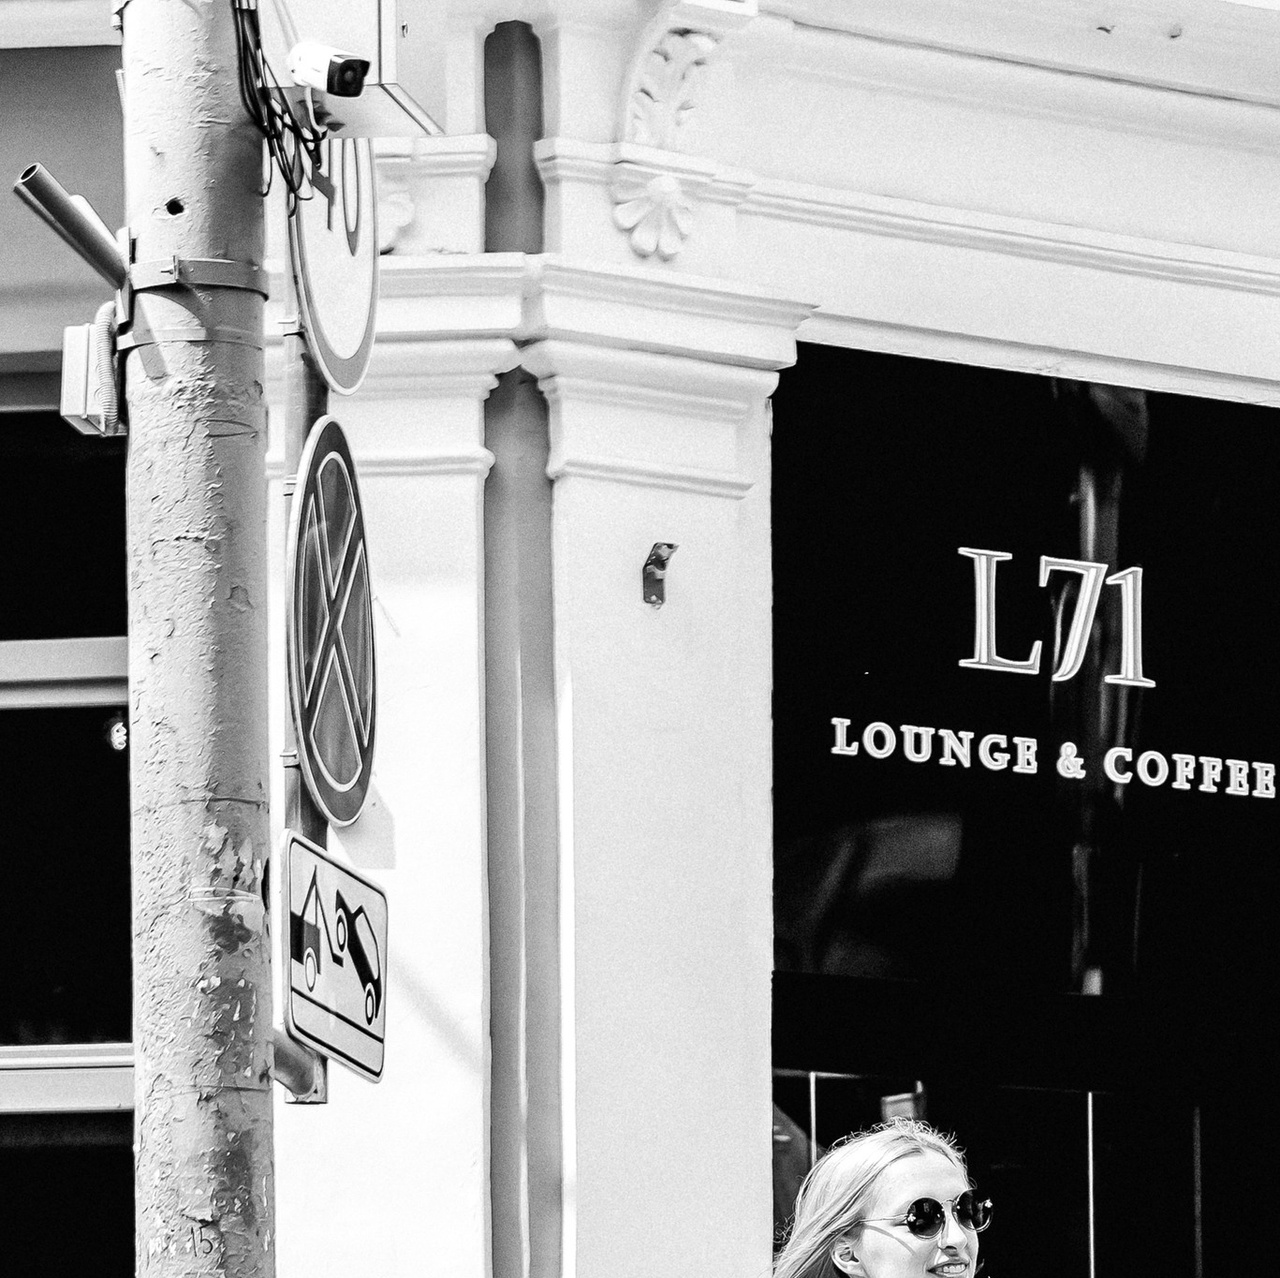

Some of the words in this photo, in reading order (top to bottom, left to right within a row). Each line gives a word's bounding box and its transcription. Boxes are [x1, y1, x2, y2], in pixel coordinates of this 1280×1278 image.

[957, 546, 1156, 688] L71
[831, 717, 1038, 774] LOUNGE
[1056, 741, 1087, 779] &
[1103, 746, 1276, 799] COFFEE
